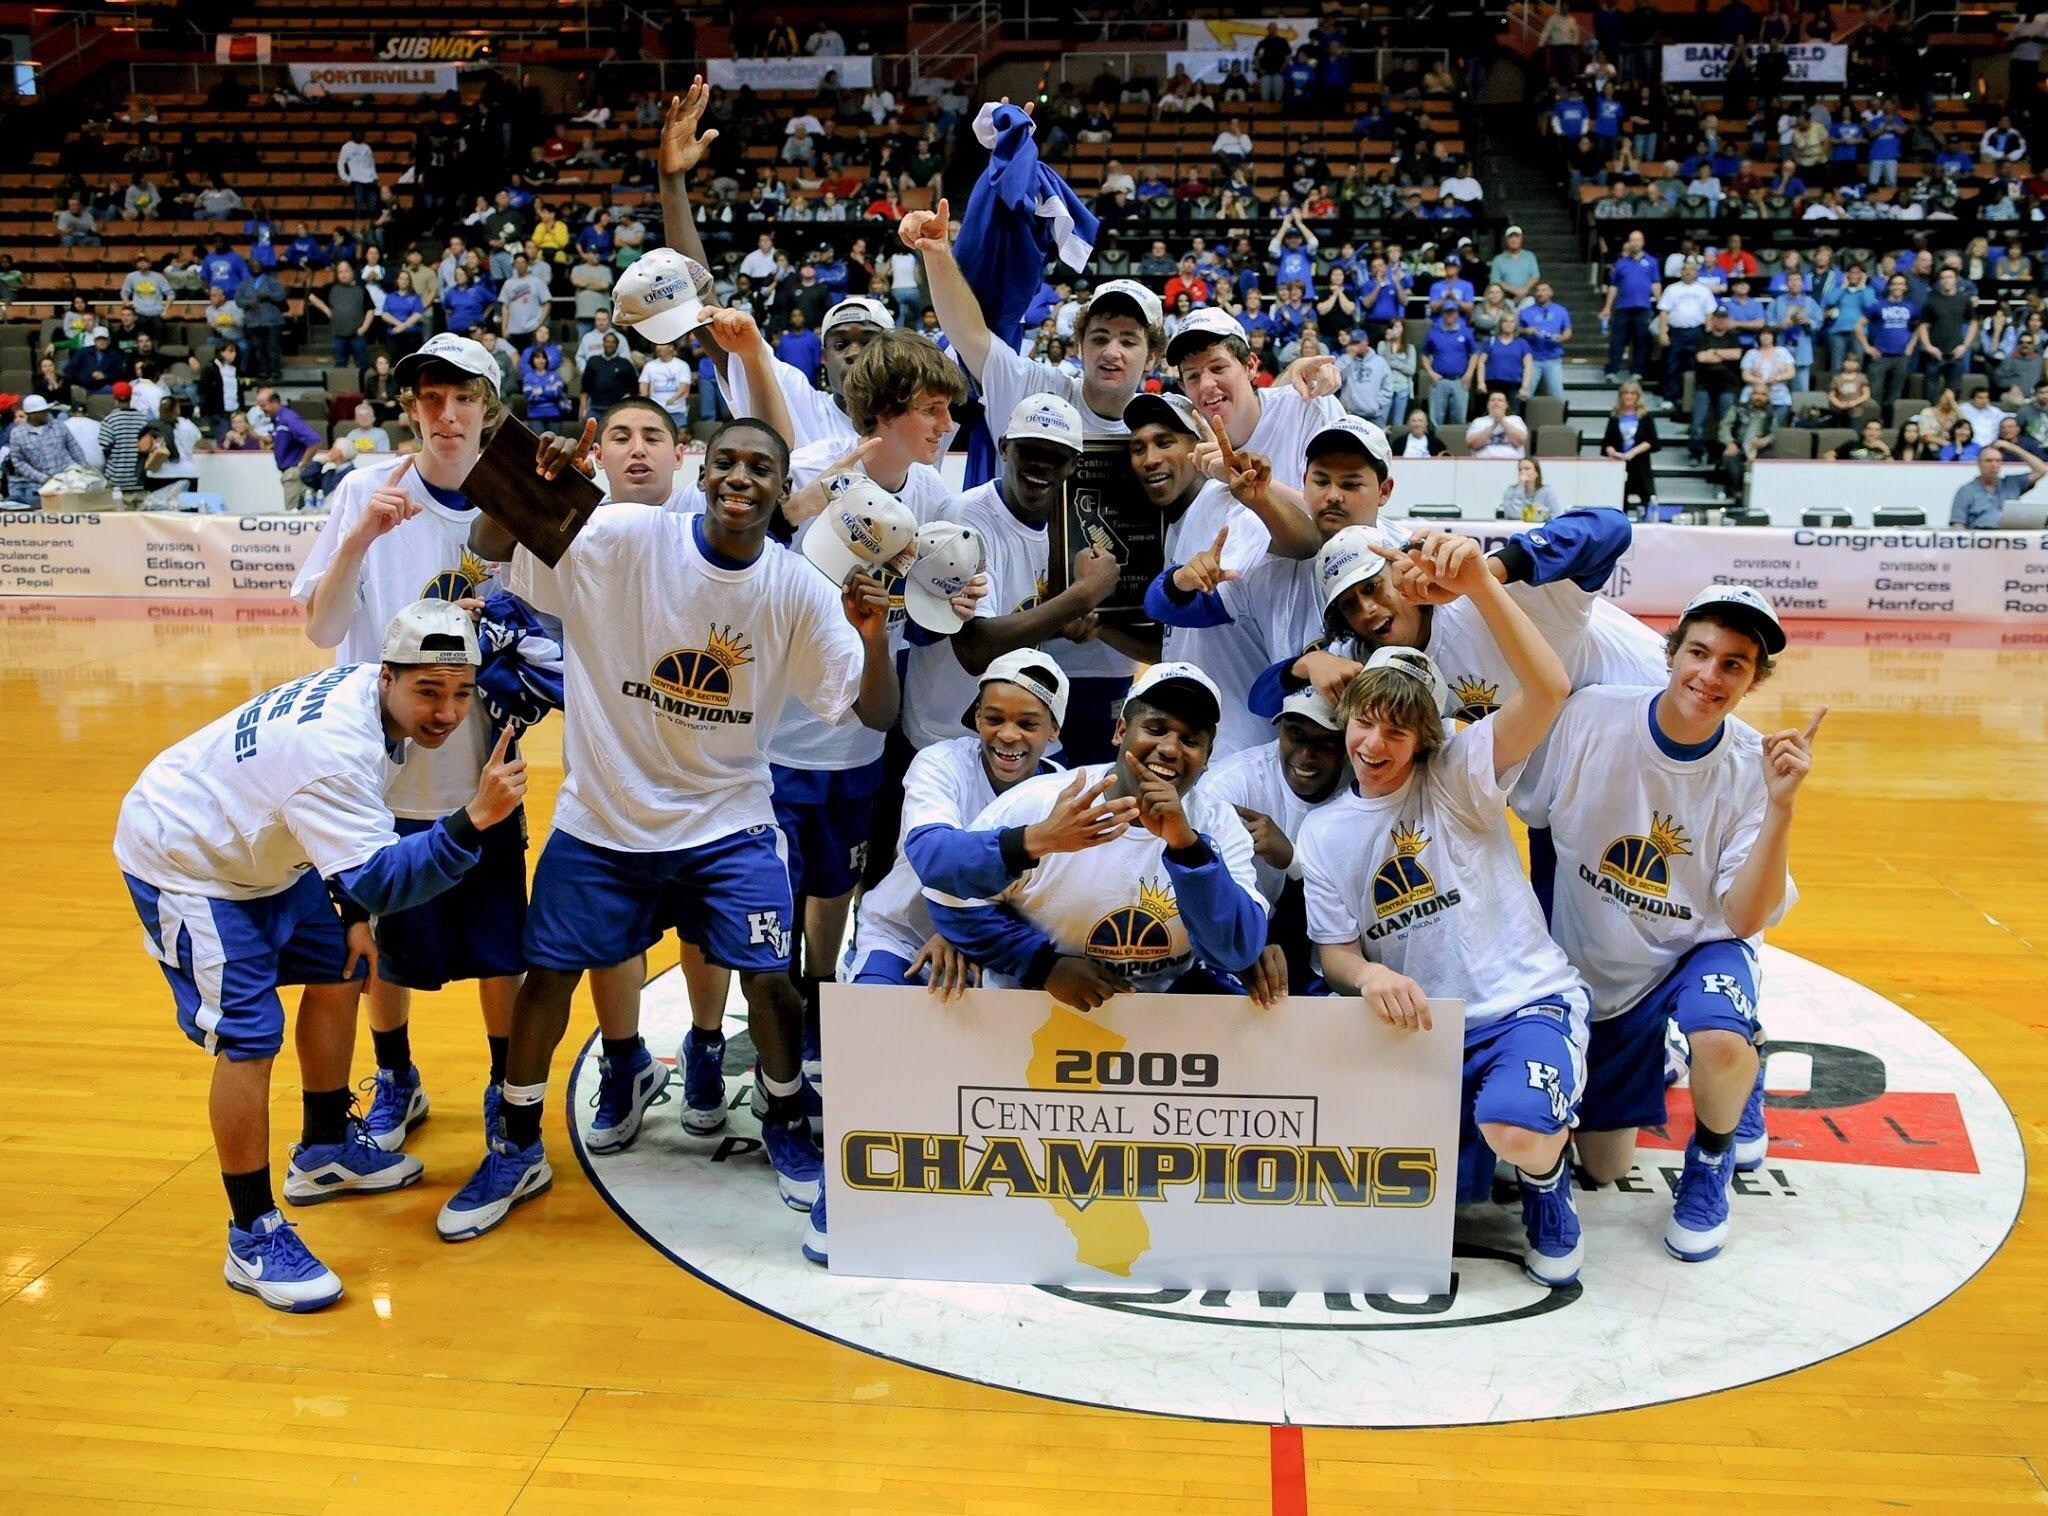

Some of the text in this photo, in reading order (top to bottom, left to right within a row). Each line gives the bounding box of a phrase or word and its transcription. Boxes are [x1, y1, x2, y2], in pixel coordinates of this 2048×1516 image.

[377, 37, 490, 60] SUBWAY
[310, 69, 436, 84] PORTERVILLE
[0, 511, 101, 527] ponsors
[146, 542, 194, 552] DIVISION
[1794, 530, 2028, 551] Congratulations
[231, 543, 280, 553] DIVISION
[1, 564, 91, 575] Casa Corona
[146, 557, 206, 571] Edison
[230, 559, 296, 572] Garces
[1733, 559, 1792, 569] DIVISION
[1879, 561, 1938, 572] DIVISION
[16, 577, 54, 588] Pepsi
[144, 575, 211, 589] Central
[1712, 575, 1818, 590] Stockdale
[1875, 578, 1950, 592] Garces
[1772, 595, 1828, 609] West
[1867, 598, 1954, 612] Hanford
[651, 677, 729, 703] CENTRAL SECTION
[621, 680, 754, 725] CHAMPIONS
[1578, 863, 1693, 921] CHAMPIONS
[1638, 881, 1667, 893] SECTION
[1140, 900, 1170, 920] 2009
[1087, 946, 1169, 956] CENTRAL SECTION
[1055, 1048, 1220, 1089] 2009
[970, 1095, 1304, 1140] CENTRAL SECTION
[840, 1129, 1438, 1209] CHAMPIONS
